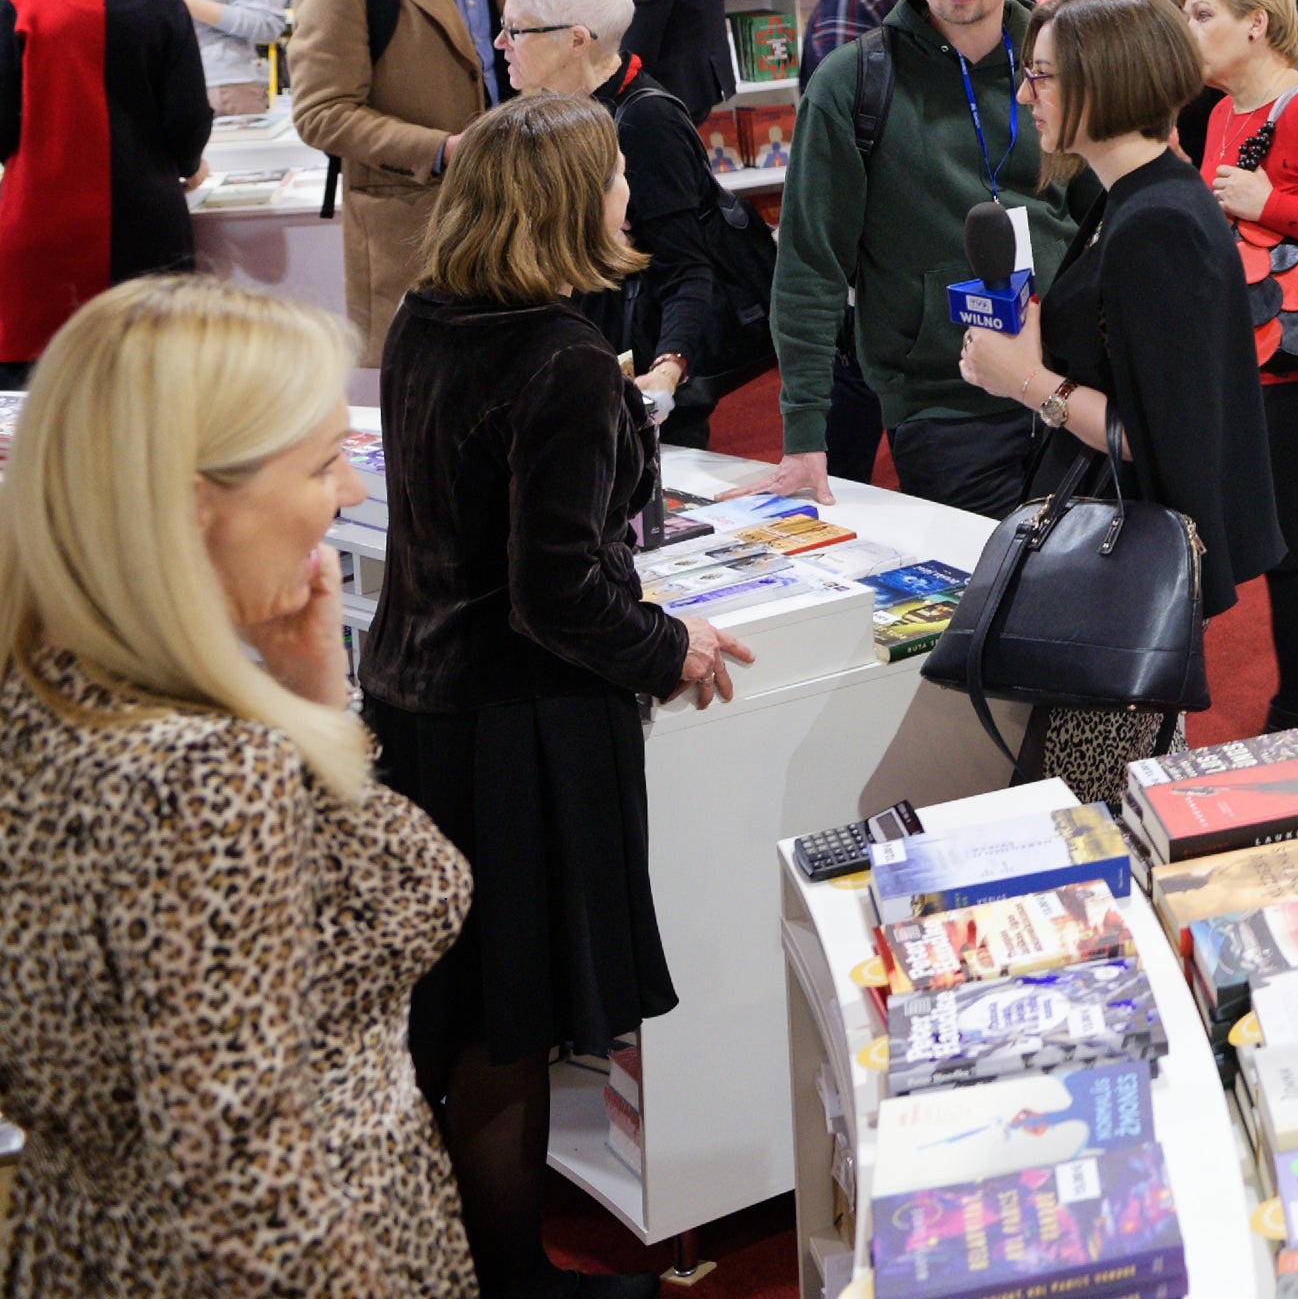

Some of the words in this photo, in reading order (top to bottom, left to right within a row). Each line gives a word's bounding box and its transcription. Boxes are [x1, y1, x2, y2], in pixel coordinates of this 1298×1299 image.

[960, 311, 1003, 330] WILNO
[905, 940, 935, 981] Peter
[922, 919, 962, 975] Handke
[905, 1014, 935, 1063] Peter
[932, 990, 961, 1059] Handke
